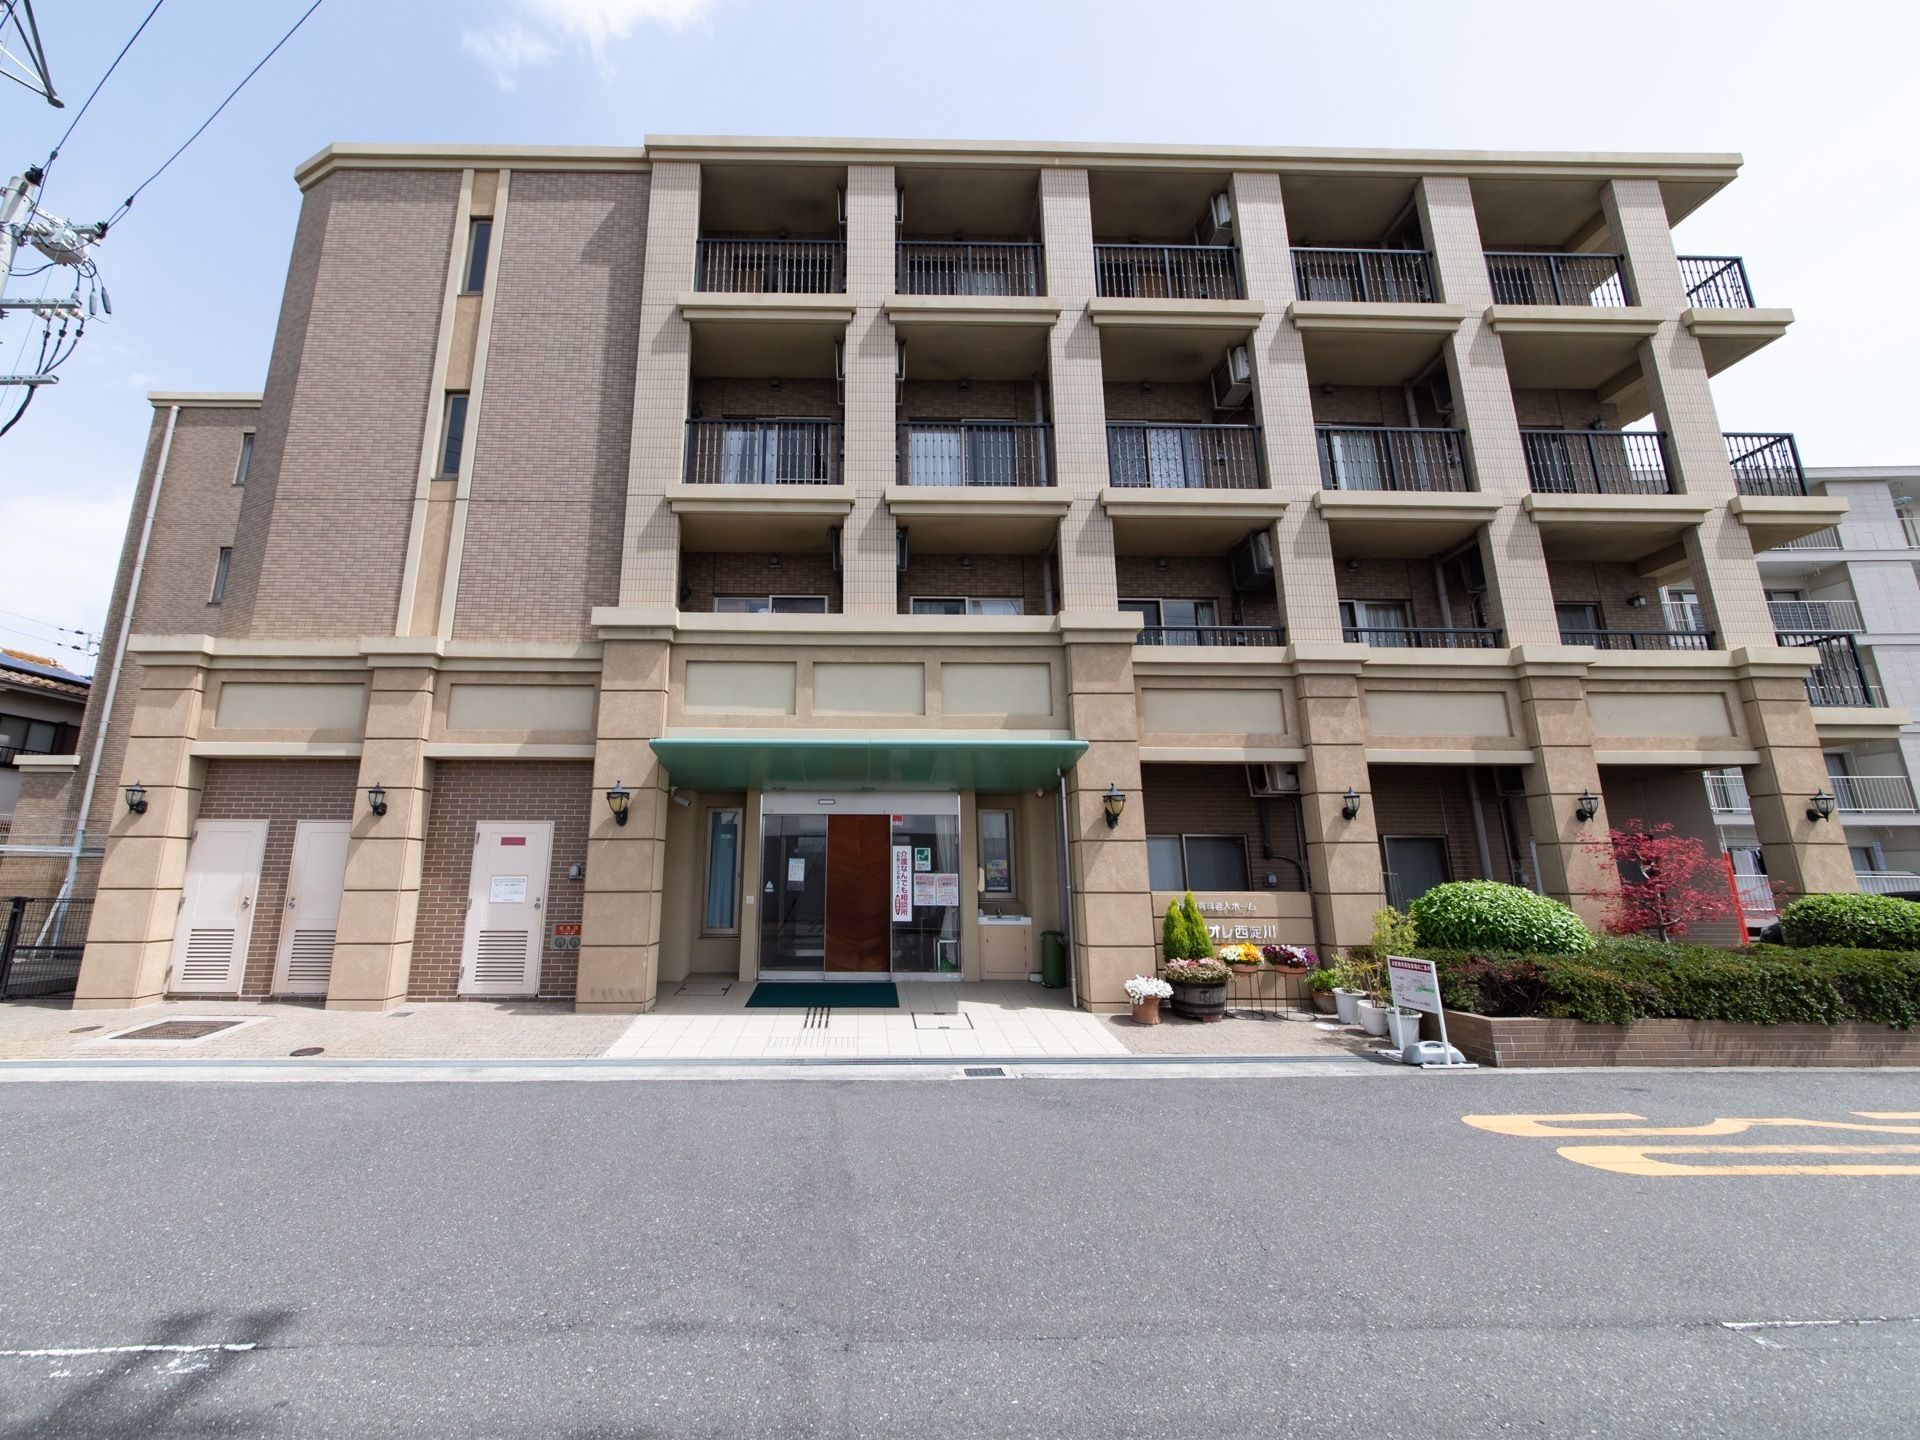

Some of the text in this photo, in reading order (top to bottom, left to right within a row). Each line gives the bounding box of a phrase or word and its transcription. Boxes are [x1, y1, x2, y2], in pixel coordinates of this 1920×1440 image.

[900, 850, 908, 916] 介護なんでも相談所
[1178, 901, 1257, 911] 有料老人ホーム
[1205, 924, 1277, 939] オレ西淀川
